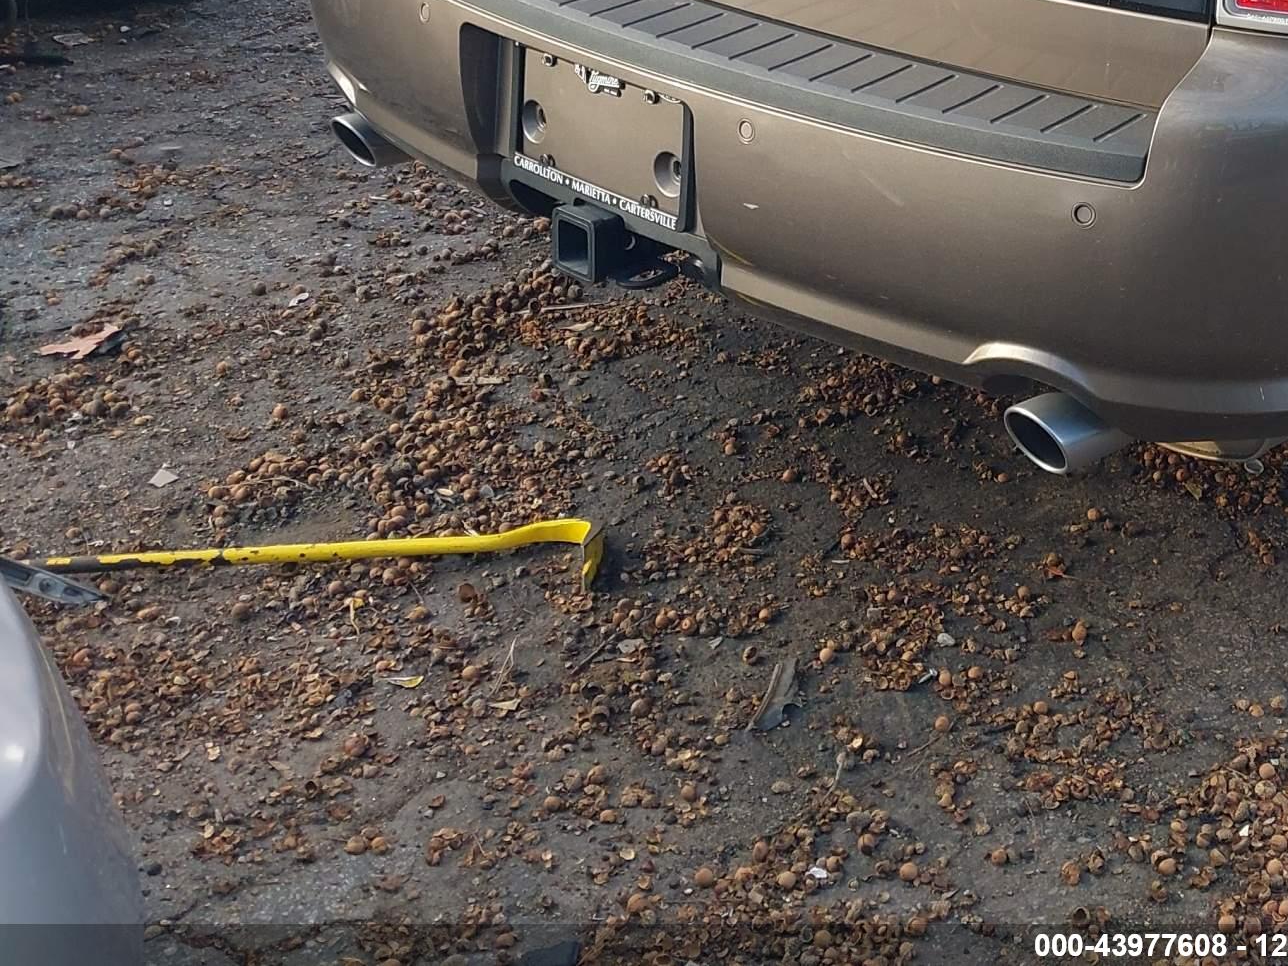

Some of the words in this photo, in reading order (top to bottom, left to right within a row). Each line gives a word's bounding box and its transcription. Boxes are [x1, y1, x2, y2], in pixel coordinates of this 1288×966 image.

[514, 155, 564, 184] CARROLLTON
[571, 178, 611, 206] MARIETTA
[619, 198, 677, 231] CARTERSVILLE
